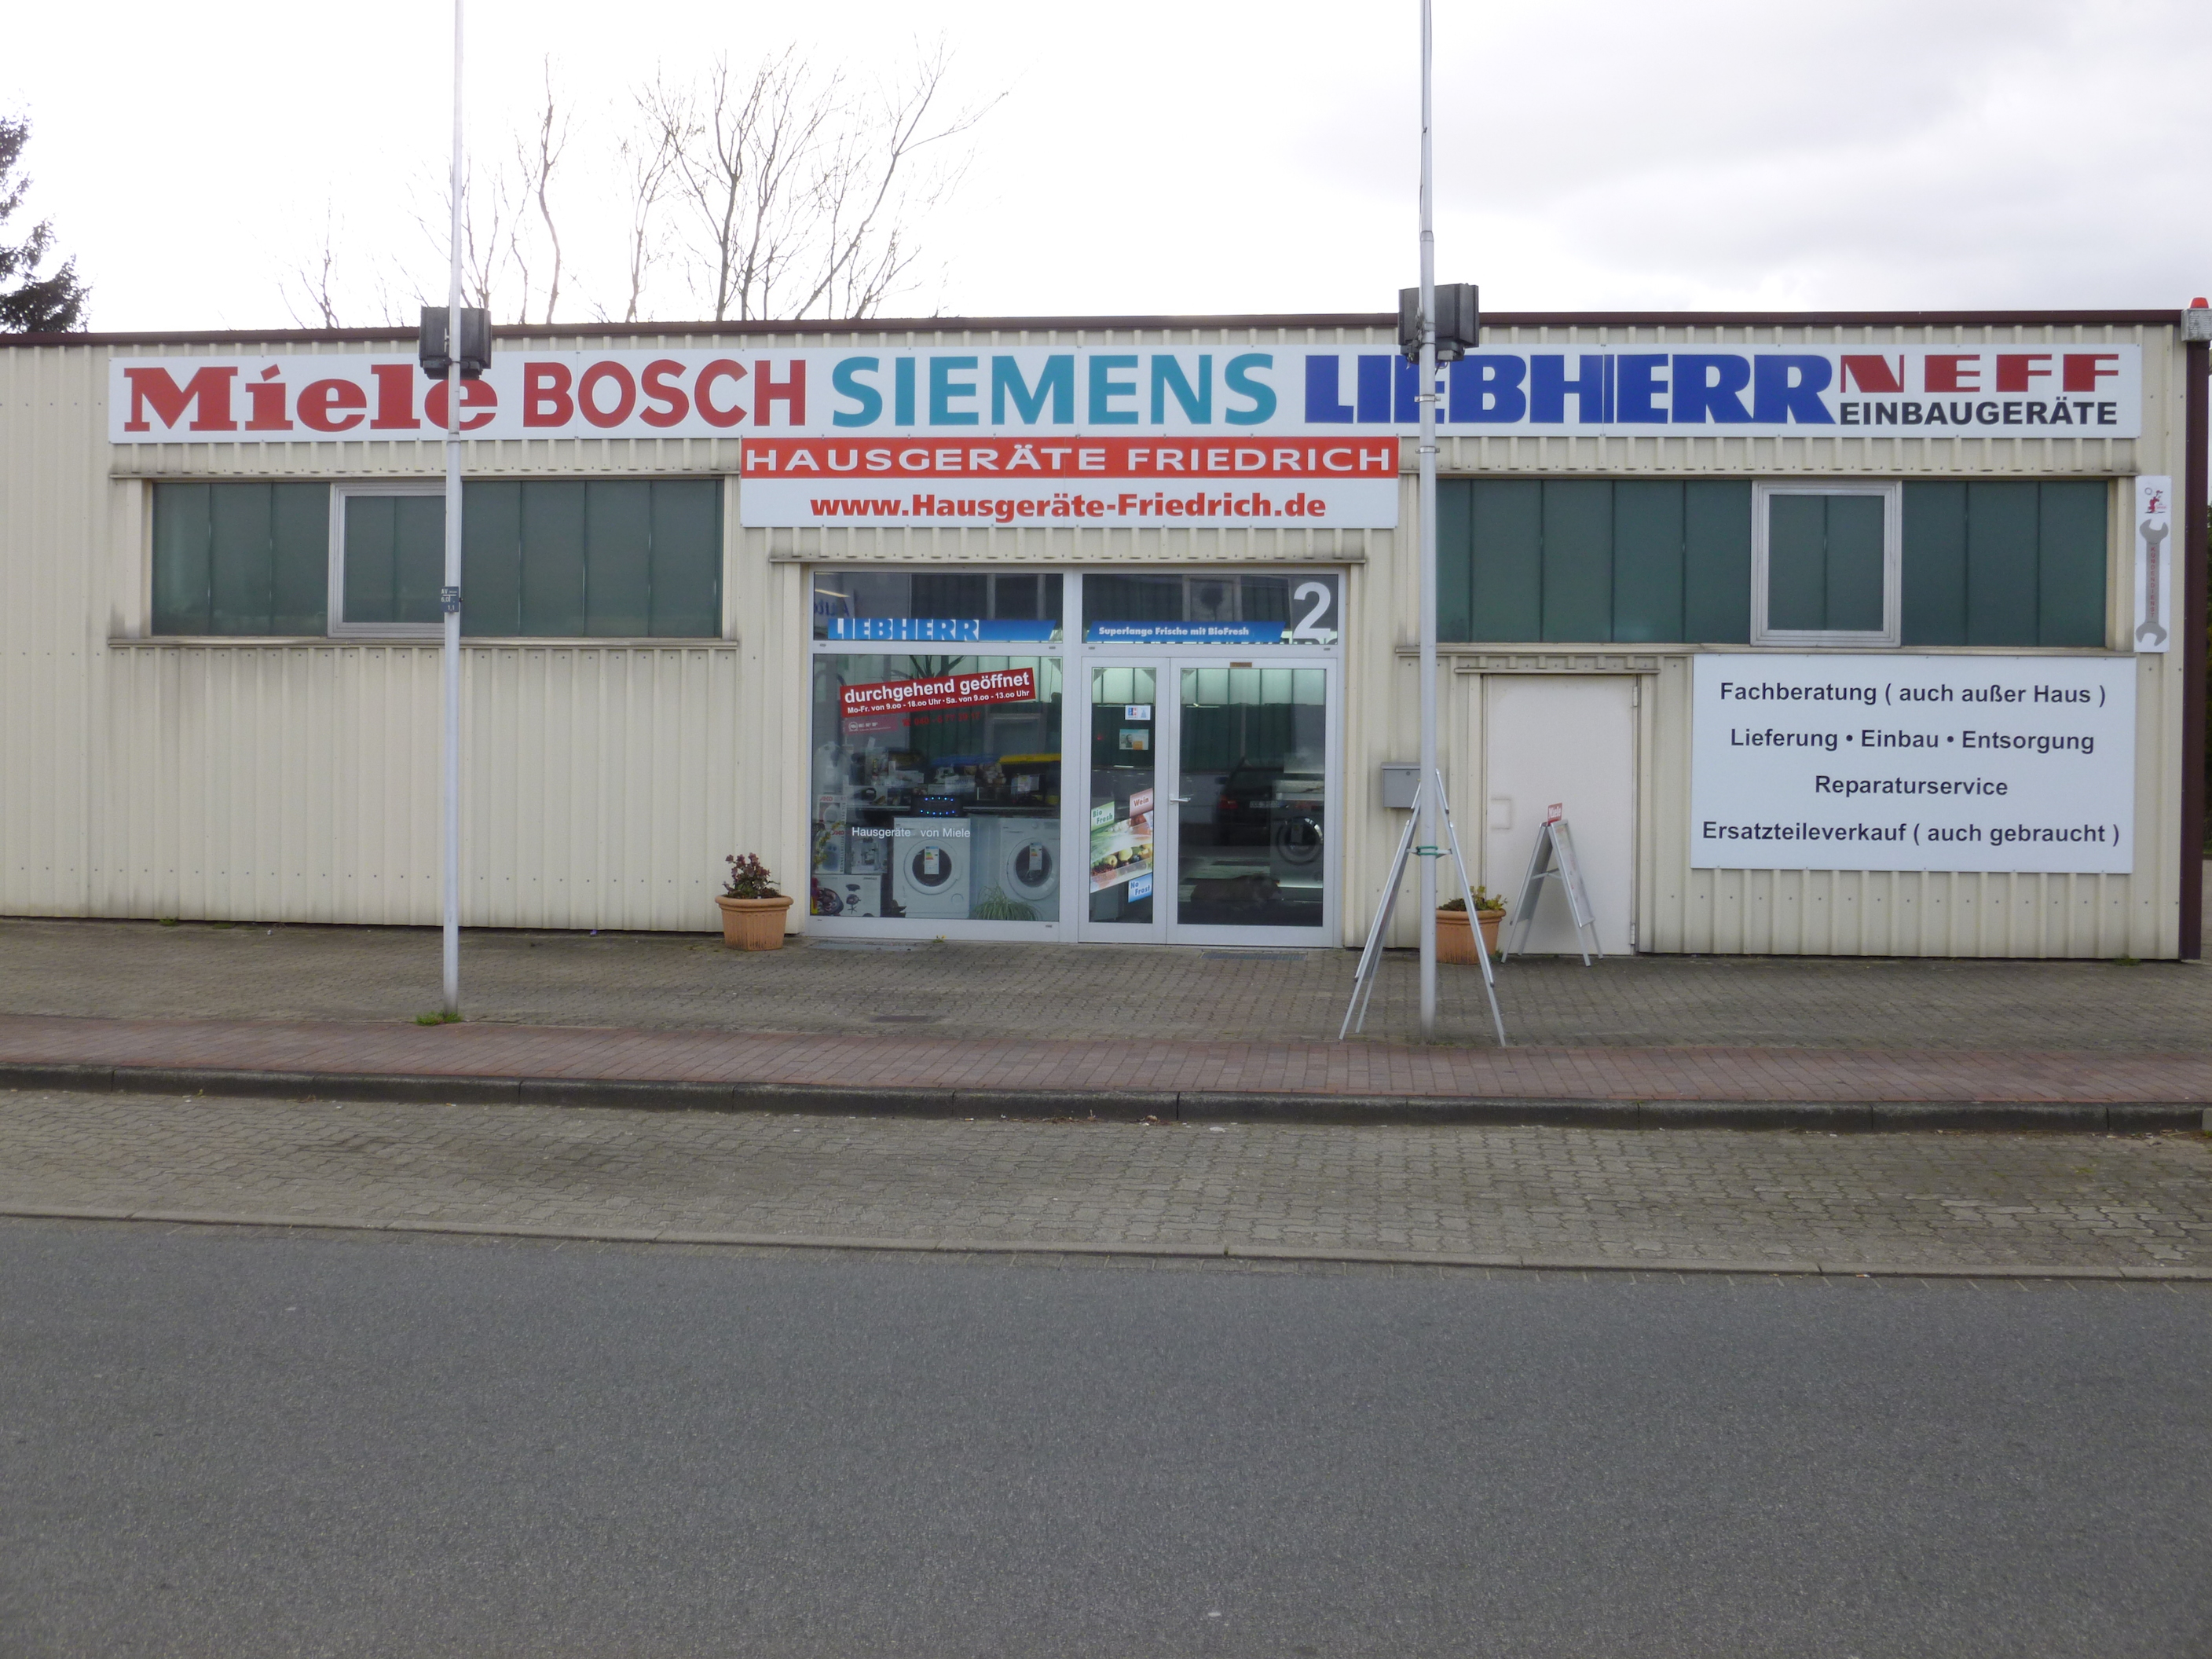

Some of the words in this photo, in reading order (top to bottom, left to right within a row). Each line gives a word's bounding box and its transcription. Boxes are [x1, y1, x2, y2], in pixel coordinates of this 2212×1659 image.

[123, 364, 498, 432] Miele
[524, 359, 806, 427] BOSCH
[833, 353, 1277, 427] SIEMENS
[1305, 353, 1836, 424] LIEBHERR
[1840, 354, 2119, 393] NEFF
[1840, 398, 2117, 425] EINBAUGERÄTE
[746, 444, 1106, 471] HAUSGERÄTE
[1128, 449, 1390, 471] FRIEDRICH
[811, 492, 1327, 523] www.Hausgeräte-Friedrich.de
[1293, 581, 1331, 639] 2
[829, 617, 980, 642] LIEBHERR
[1098, 627, 1153, 637] Superlange
[1155, 627, 1188, 635] Frische
[1208, 627, 1250, 635] BioFresh
[844, 679, 955, 704] durchgehend
[959, 672, 1030, 695] geöffnet
[1720, 682, 1877, 705] Fachberatung
[1961, 684, 2027, 703] außer
[2034, 685, 2091, 703] Haus
[1730, 728, 1838, 752] Lieferung
[1861, 729, 1939, 749] Einbau
[1961, 731, 2095, 754] Entsorgung
[1815, 775, 2009, 798] Reparaturservice
[1093, 809, 1103, 818] Bio
[1133, 797, 1149, 808] Wein
[1096, 812, 1114, 825] Fresh
[851, 826, 911, 839] Hausgeräte
[920, 830, 939, 838] von
[943, 828, 971, 838] Miele
[1702, 821, 1907, 842] Ersatzteileverkauf
[1990, 824, 2105, 846] gebraucht
[1134, 884, 1151, 896] Frost
